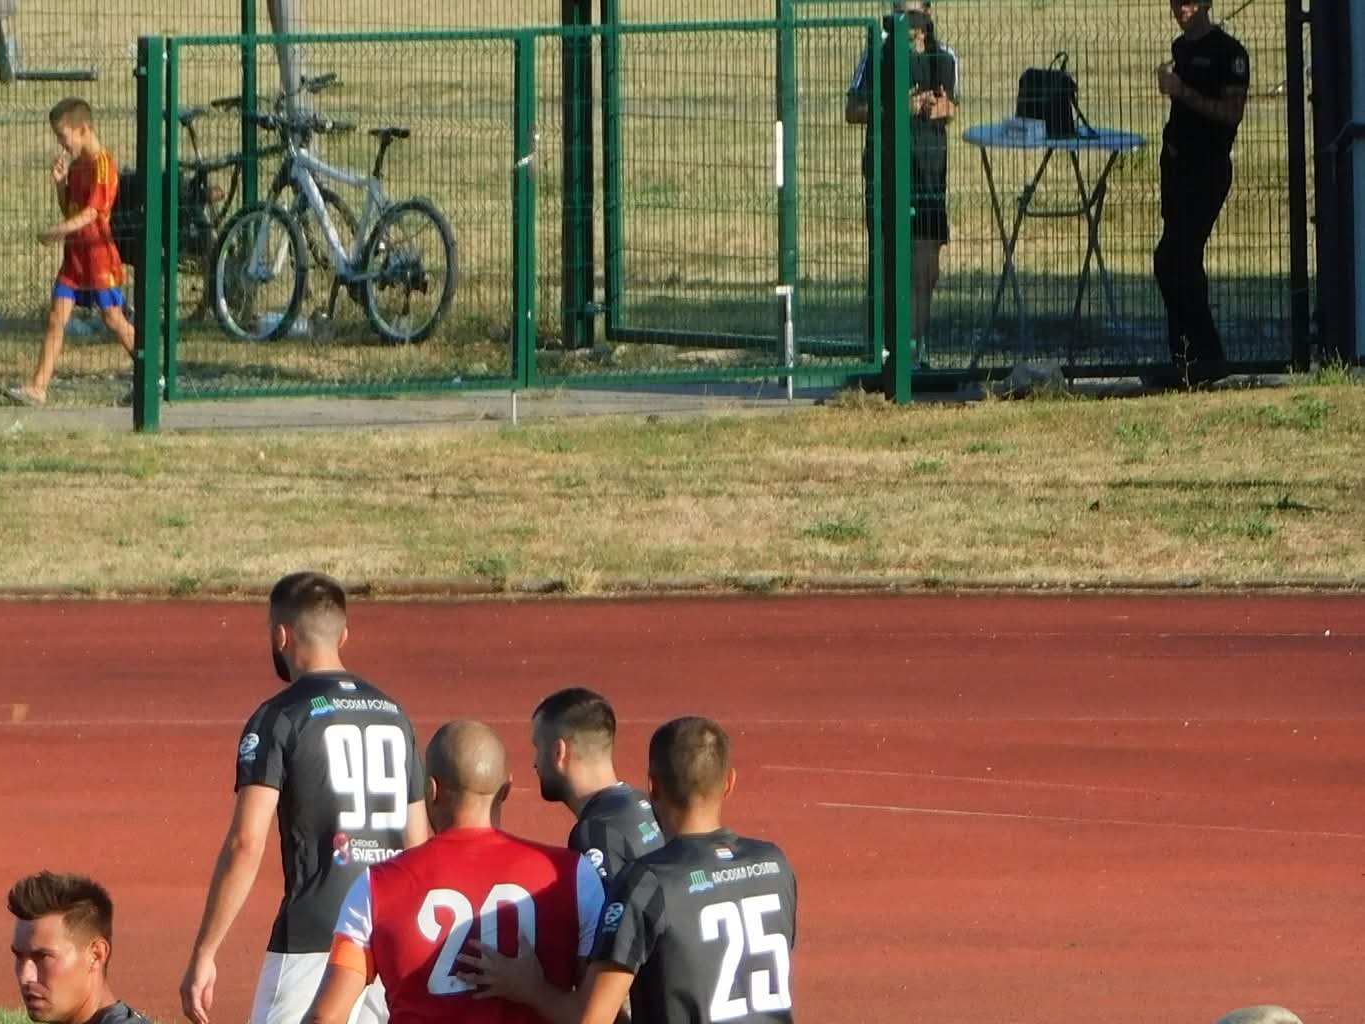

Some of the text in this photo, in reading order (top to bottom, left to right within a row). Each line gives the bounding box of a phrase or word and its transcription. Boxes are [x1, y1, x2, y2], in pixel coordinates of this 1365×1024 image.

[324, 724, 408, 829] 99
[351, 847, 403, 863] SVJETLO
[417, 883, 536, 995] 20
[700, 893, 792, 1023] 25
